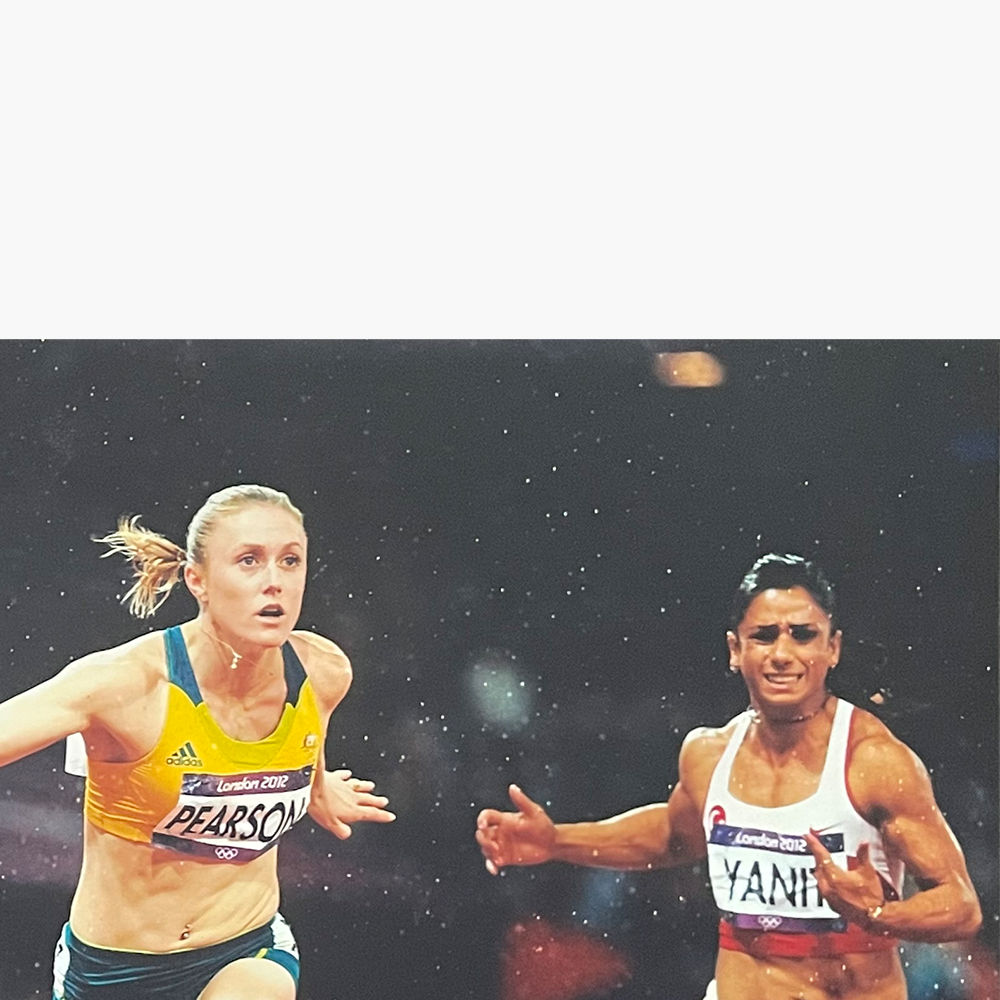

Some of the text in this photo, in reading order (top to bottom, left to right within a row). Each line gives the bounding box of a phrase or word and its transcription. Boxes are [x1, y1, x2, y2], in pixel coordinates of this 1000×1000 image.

[165, 757, 203, 767] adidas
[216, 775, 289, 793] London 2012
[164, 797, 306, 842] PEARSON
[734, 832, 808, 852] London 2012
